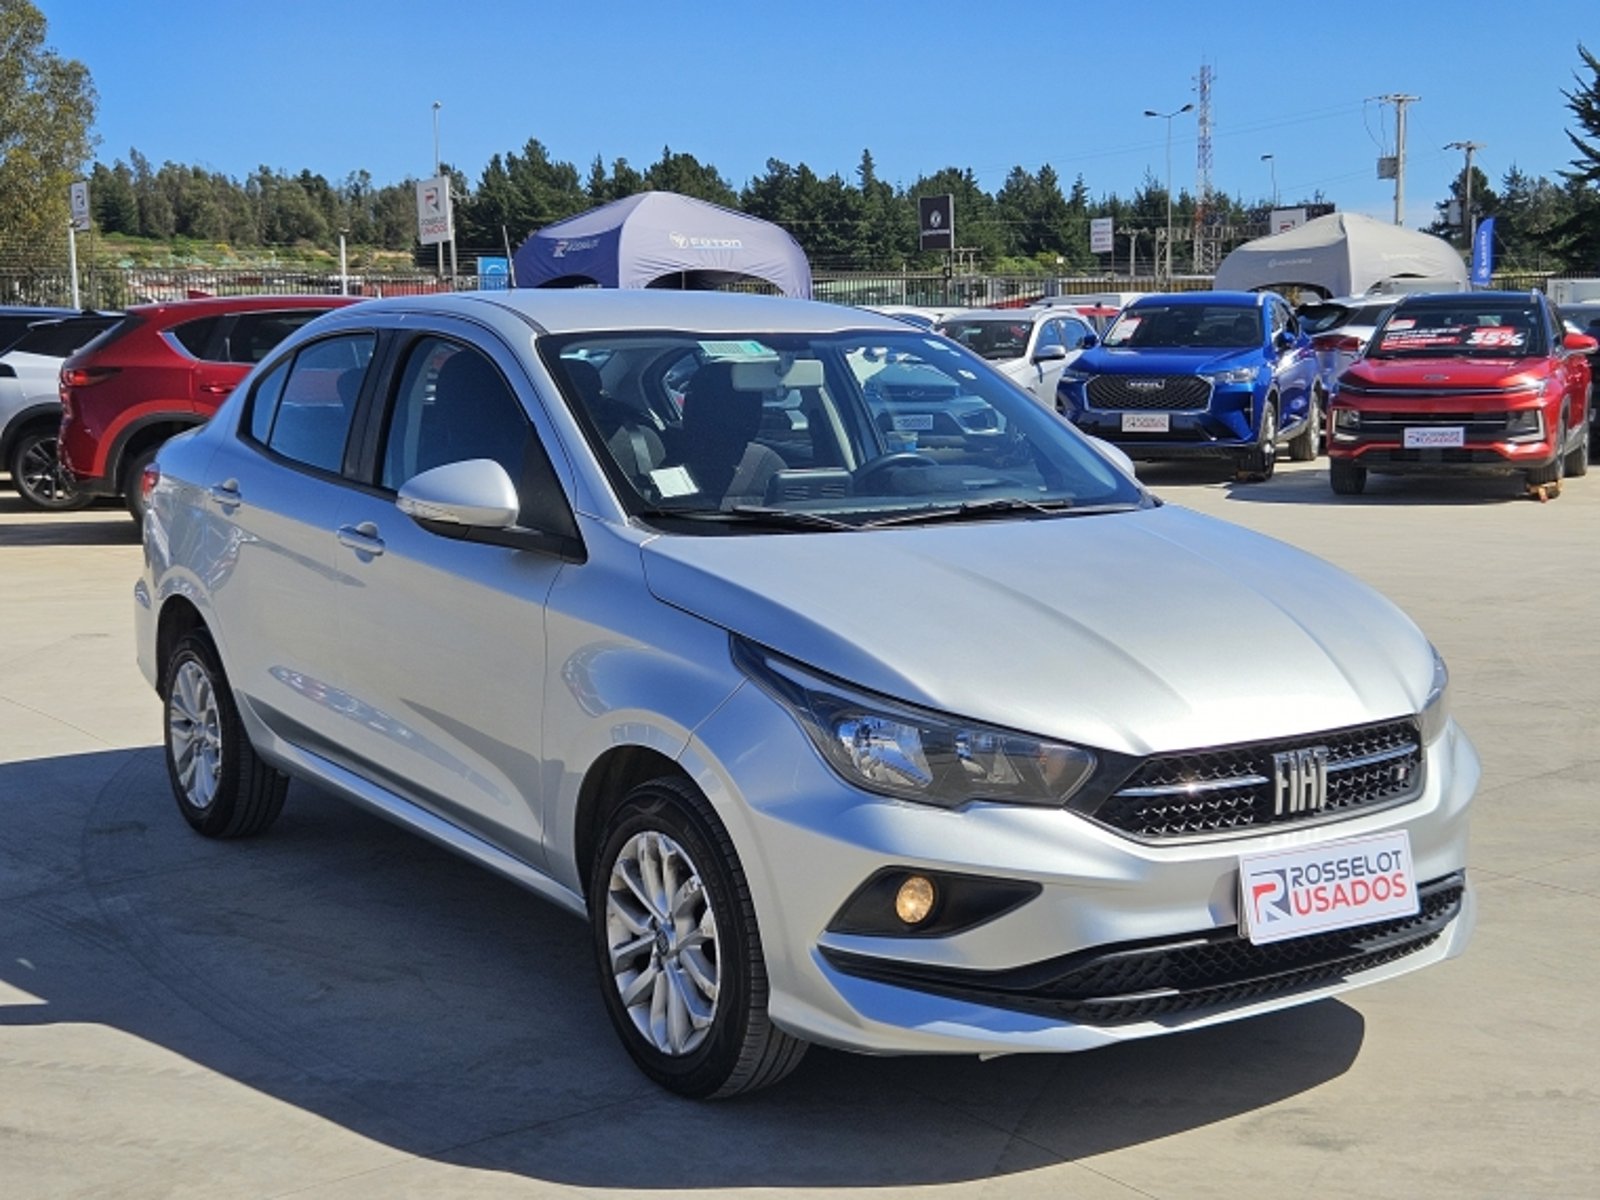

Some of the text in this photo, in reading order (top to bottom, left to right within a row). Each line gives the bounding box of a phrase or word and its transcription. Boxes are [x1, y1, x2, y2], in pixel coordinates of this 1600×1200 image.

[1466, 331, 1523, 346] 35%
[1272, 746, 1329, 816] FIAT
[1290, 850, 1402, 888] ROSSELOT
[1293, 872, 1408, 916] USADOS
